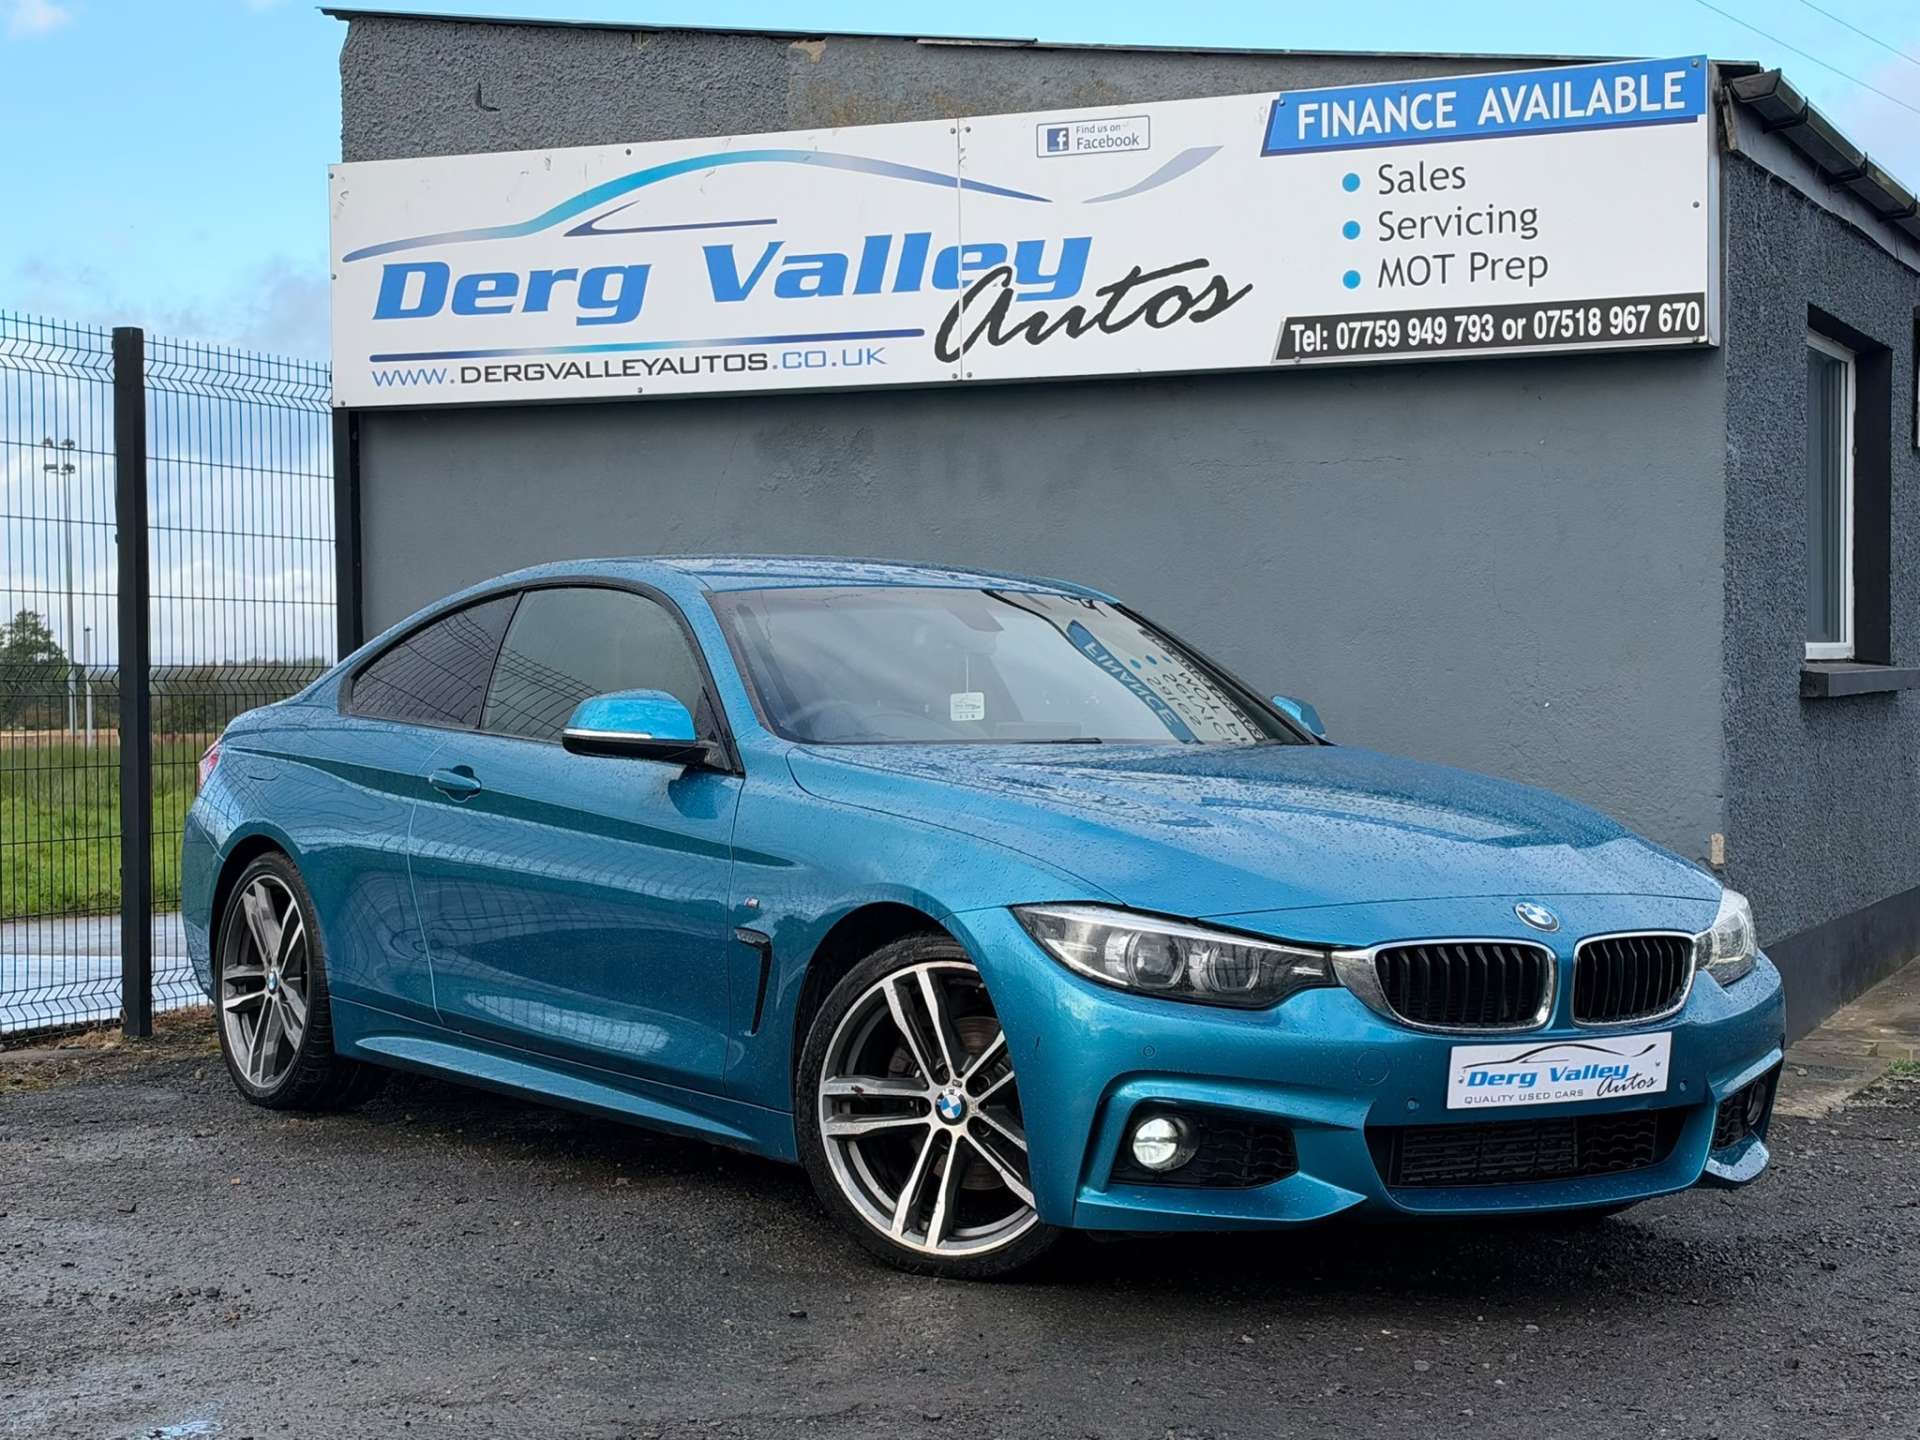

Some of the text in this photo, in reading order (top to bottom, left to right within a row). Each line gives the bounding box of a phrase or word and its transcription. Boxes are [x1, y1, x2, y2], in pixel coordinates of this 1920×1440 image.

[1297, 70, 1686, 140] FINANCE AVAILABLE
[1076, 123, 1121, 134] Find us on
[1076, 133, 1140, 150] Facebook
[1378, 160, 1466, 195] Sales
[1378, 203, 1539, 242] Servicing
[372, 232, 1093, 326] Derg Valley
[1377, 251, 1549, 288] MOT Prep
[934, 258, 1253, 363] Autos
[1290, 301, 1700, 353] Tel: 07759 949 793 or 07518 967 670
[371, 347, 887, 387] WWW.DERGVALLEYAUTOS.CO.UK
[1467, 1064, 1629, 1088] Derg Valley
[1596, 1071, 1657, 1098] Autos
[1464, 1088, 1584, 1105] QUALITY USED CARS
